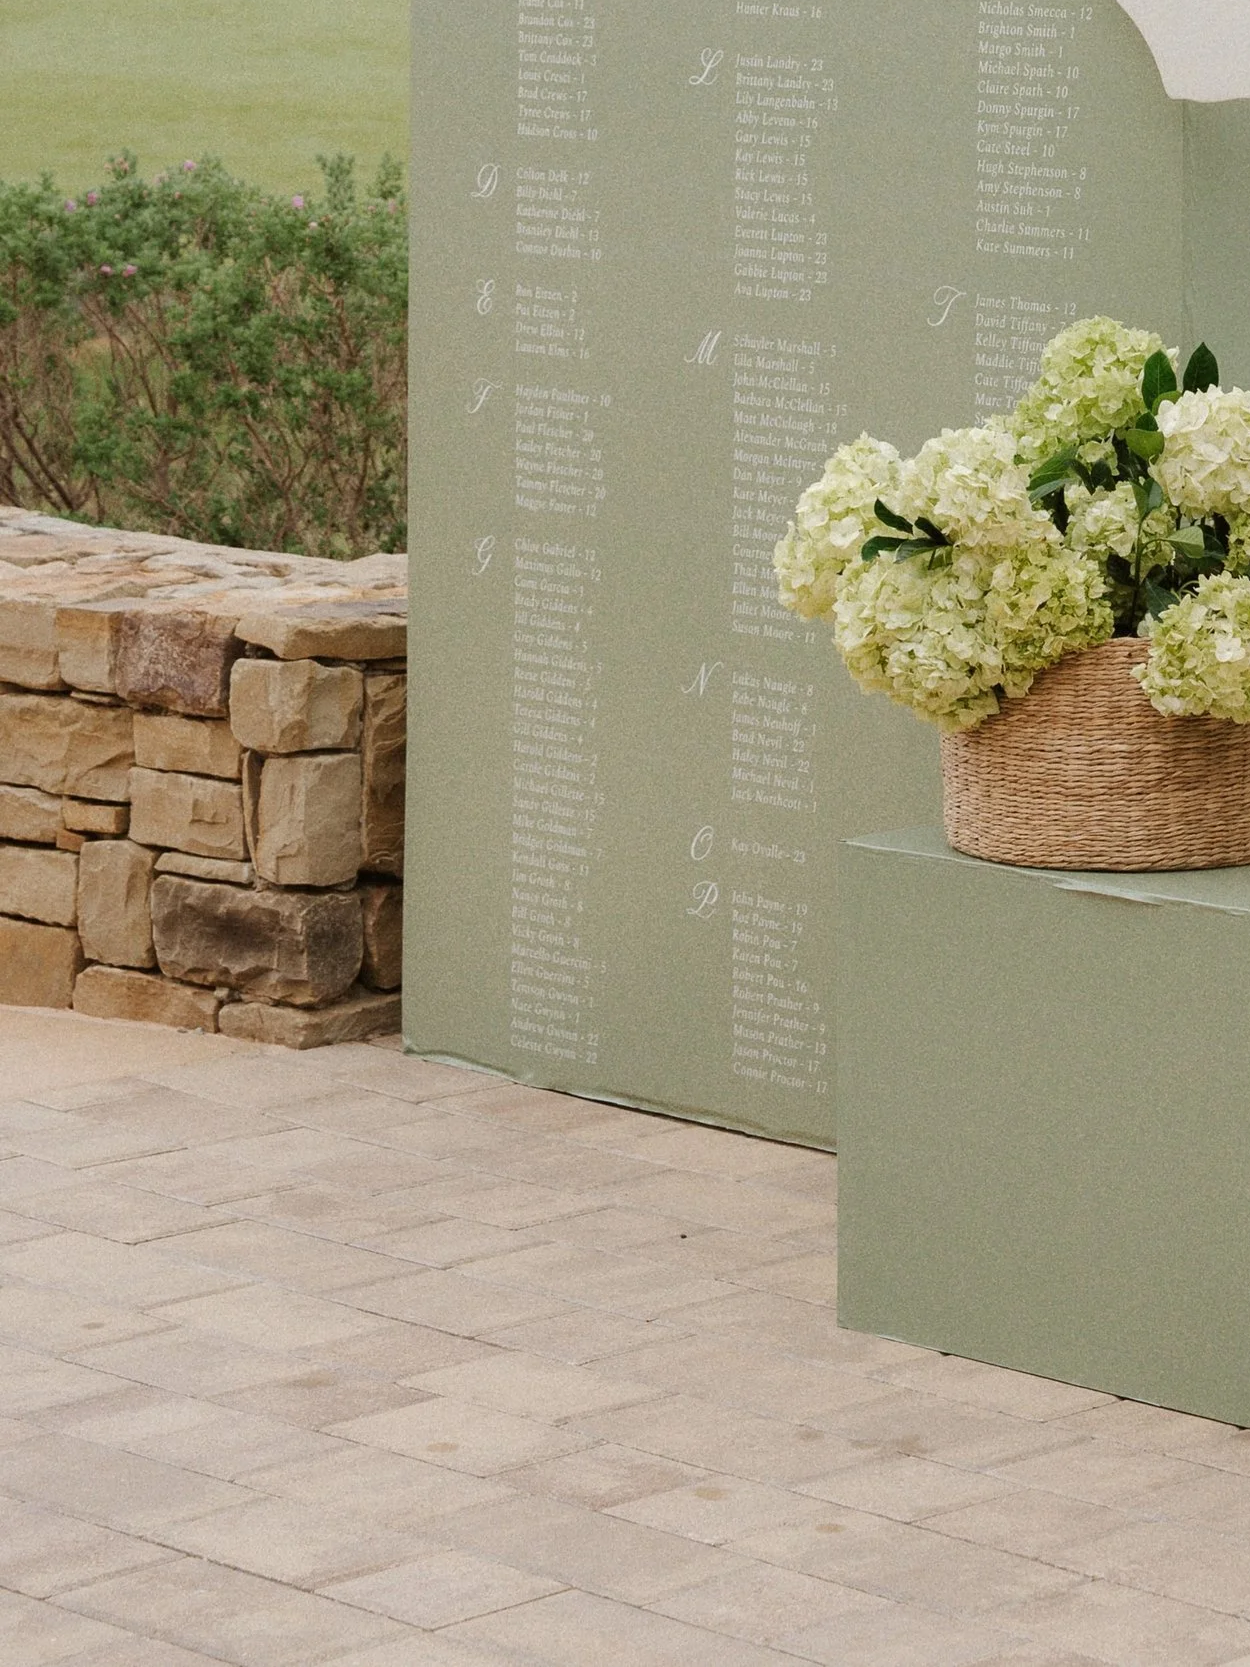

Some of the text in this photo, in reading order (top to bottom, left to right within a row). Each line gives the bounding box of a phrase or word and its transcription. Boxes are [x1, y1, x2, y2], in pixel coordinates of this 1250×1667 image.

[979, 2, 1093, 20] Nicholas Smecca 12
[689, 47, 725, 85] L
[735, 54, 823, 72] Justin Landry 23
[978, 61, 1079, 80] Michael Spath 10
[977, 101, 1080, 120] Donny Spurgin 17
[736, 130, 811, 147] Gary Lewis 15
[471, 164, 501, 198] D
[977, 160, 1086, 181] Hugh Stephenson 8
[976, 219, 1090, 240] Charlie Summers 11
[476, 279, 495, 315] E
[927, 286, 967, 326] T
[975, 295, 1076, 316] James Thomas 12
[684, 330, 722, 366] M
[467, 378, 503, 414] F
[472, 535, 495, 575] G
[732, 620, 814, 643] Susan Moore 11
[681, 661, 724, 695] N
[690, 825, 715, 861] O
[731, 839, 805, 863] Kay Ovalle 23
[686, 881, 719, 919] P
[586, 1052, 597, 1064] 22
[733, 1062, 828, 1094] Connie Proctor 17
